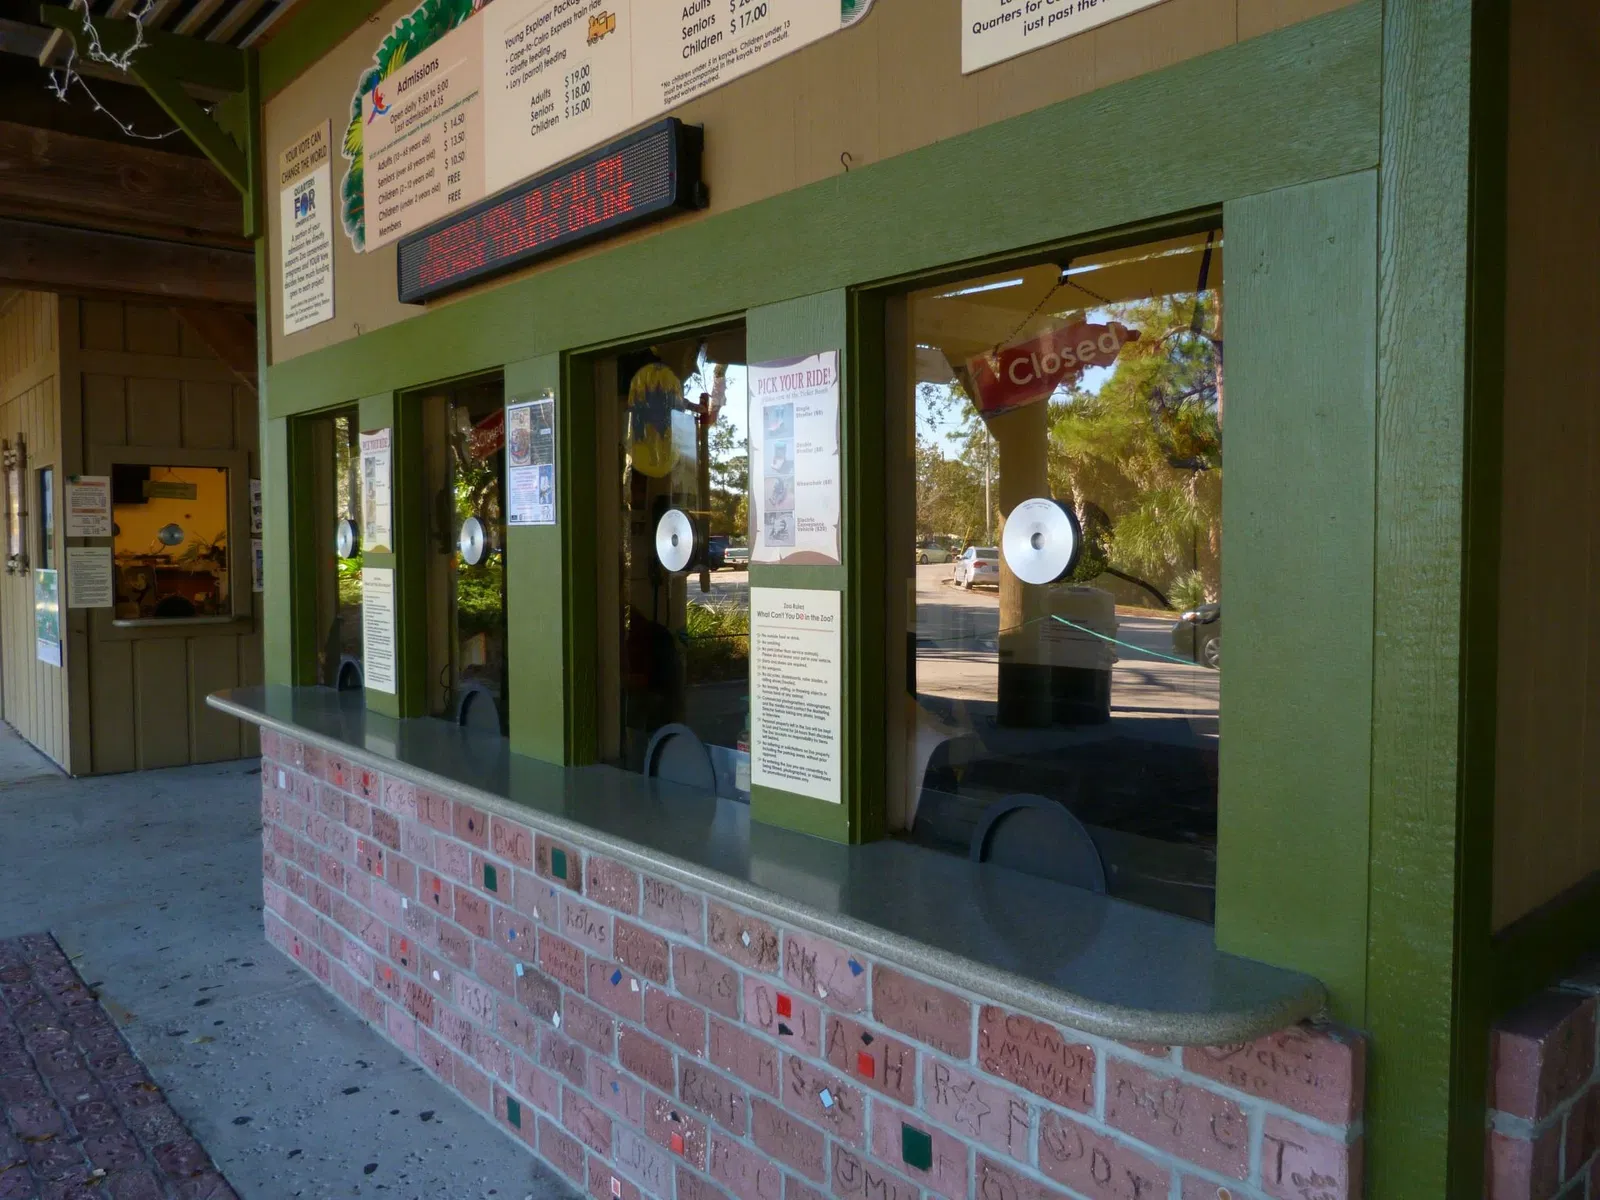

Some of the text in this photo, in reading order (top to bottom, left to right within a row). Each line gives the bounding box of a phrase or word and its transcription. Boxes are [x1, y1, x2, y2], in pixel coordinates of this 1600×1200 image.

[682, 0, 710, 20] Adults
[682, 0, 736, 40] Seniors $
[972, 1, 1042, 34] Quarters for
[1024, 0, 1097, 36] just past the
[505, 30, 524, 49] Young
[526, 12, 552, 36] Explorer
[510, 0, 602, 63] Cape-to-Cairo Express train ride
[682, 3, 766, 58] Children $ 17.00
[510, 45, 551, 76] Giraffe feeding
[510, 49, 567, 90] Lory (parrot) feeding
[664, 86, 675, 96] must
[684, 64, 719, 86] accompanied
[736, 48, 753, 60] kayak
[754, 44, 762, 52] by
[763, 40, 771, 48] an
[672, 70, 691, 84] children
[692, 63, 706, 74] under
[740, 34, 764, 50] Children
[765, 26, 782, 38] under
[784, 20, 790, 28] 13
[397, 58, 439, 96] Admissions
[530, 64, 590, 107] Adults $ 19.00
[664, 92, 680, 104] Signed
[681, 86, 696, 96] waiver
[390, 110, 404, 124] Open
[404, 101, 416, 117] daily
[430, 89, 436, 98] to
[437, 79, 449, 94] 5:00
[394, 121, 404, 134] Last
[406, 104, 432, 126] admission
[530, 80, 590, 122] Seniors $ 18.00
[530, 98, 590, 136] Children $ 15.00
[282, 144, 327, 184] CHANGE THE WORLD
[286, 130, 322, 164] YOUR VOTE CAN
[378, 155, 392, 172] Adults
[408, 141, 421, 156] years
[378, 172, 395, 188] Seniors
[414, 155, 426, 170] years
[378, 188, 398, 204] Children
[413, 174, 424, 188] years
[596, 152, 622, 191] PM
[294, 188, 316, 220] FOR
[378, 204, 400, 221] Children
[418, 189, 430, 203] years
[448, 171, 461, 186] FREE
[379, 189, 462, 237] Members FREE
[492, 212, 560, 258] TICKETS
[568, 181, 634, 232] ONLINE
[1008, 323, 1120, 385] Closed
[758, 368, 831, 394] PICK YOUR RIDE!
